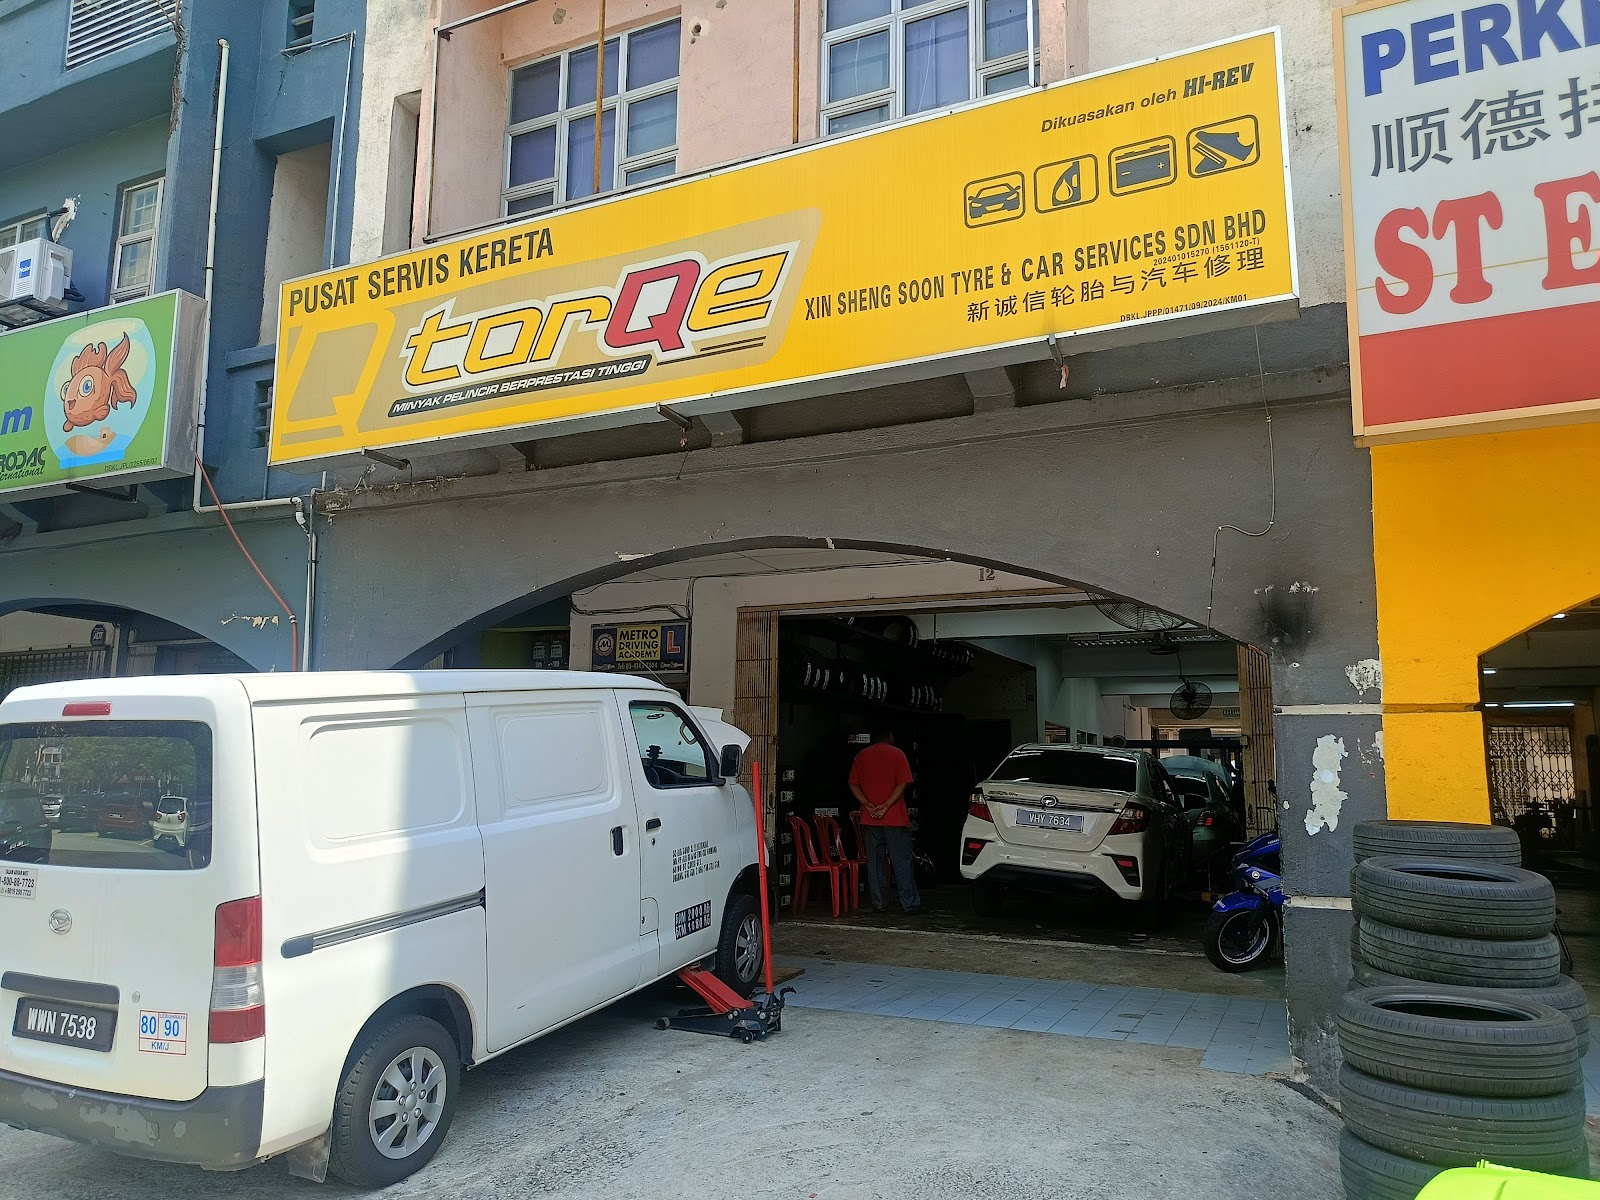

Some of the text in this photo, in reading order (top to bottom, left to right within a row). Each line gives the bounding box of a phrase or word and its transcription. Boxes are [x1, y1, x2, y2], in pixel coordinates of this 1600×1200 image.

[1361, 0, 1600, 97] PERK
[1041, 62, 1255, 133] Dikuasakan oleh HI-REV
[805, 209, 1266, 320] XIN SHENG SOON TYRE & CAR SERVICES SDN BHD
[1153, 237, 1260, 266] 202401015270 (1561120-T)
[1374, 190, 1503, 315] ST
[289, 227, 554, 317] PUSAT SERVIS KERETA
[967, 247, 1265, 323] 新诚信轮胎与汽车修理
[402, 249, 791, 388] torQe
[392, 359, 648, 413] MINYAK PELINCIR BERPRESTASI TINGGI
[979, 568, 995, 581] 12
[619, 628, 659, 640] METRO
[619, 640, 659, 650] DRIVING
[667, 630, 680, 653] L
[618, 650, 658, 658] ACADEMY
[1028, 813, 1070, 827] VHY 7634
[27, 1007, 97, 1040] WWN 7538
[141, 1015, 180, 1037] 80 90
[151, 1041, 169, 1051] KM/J
